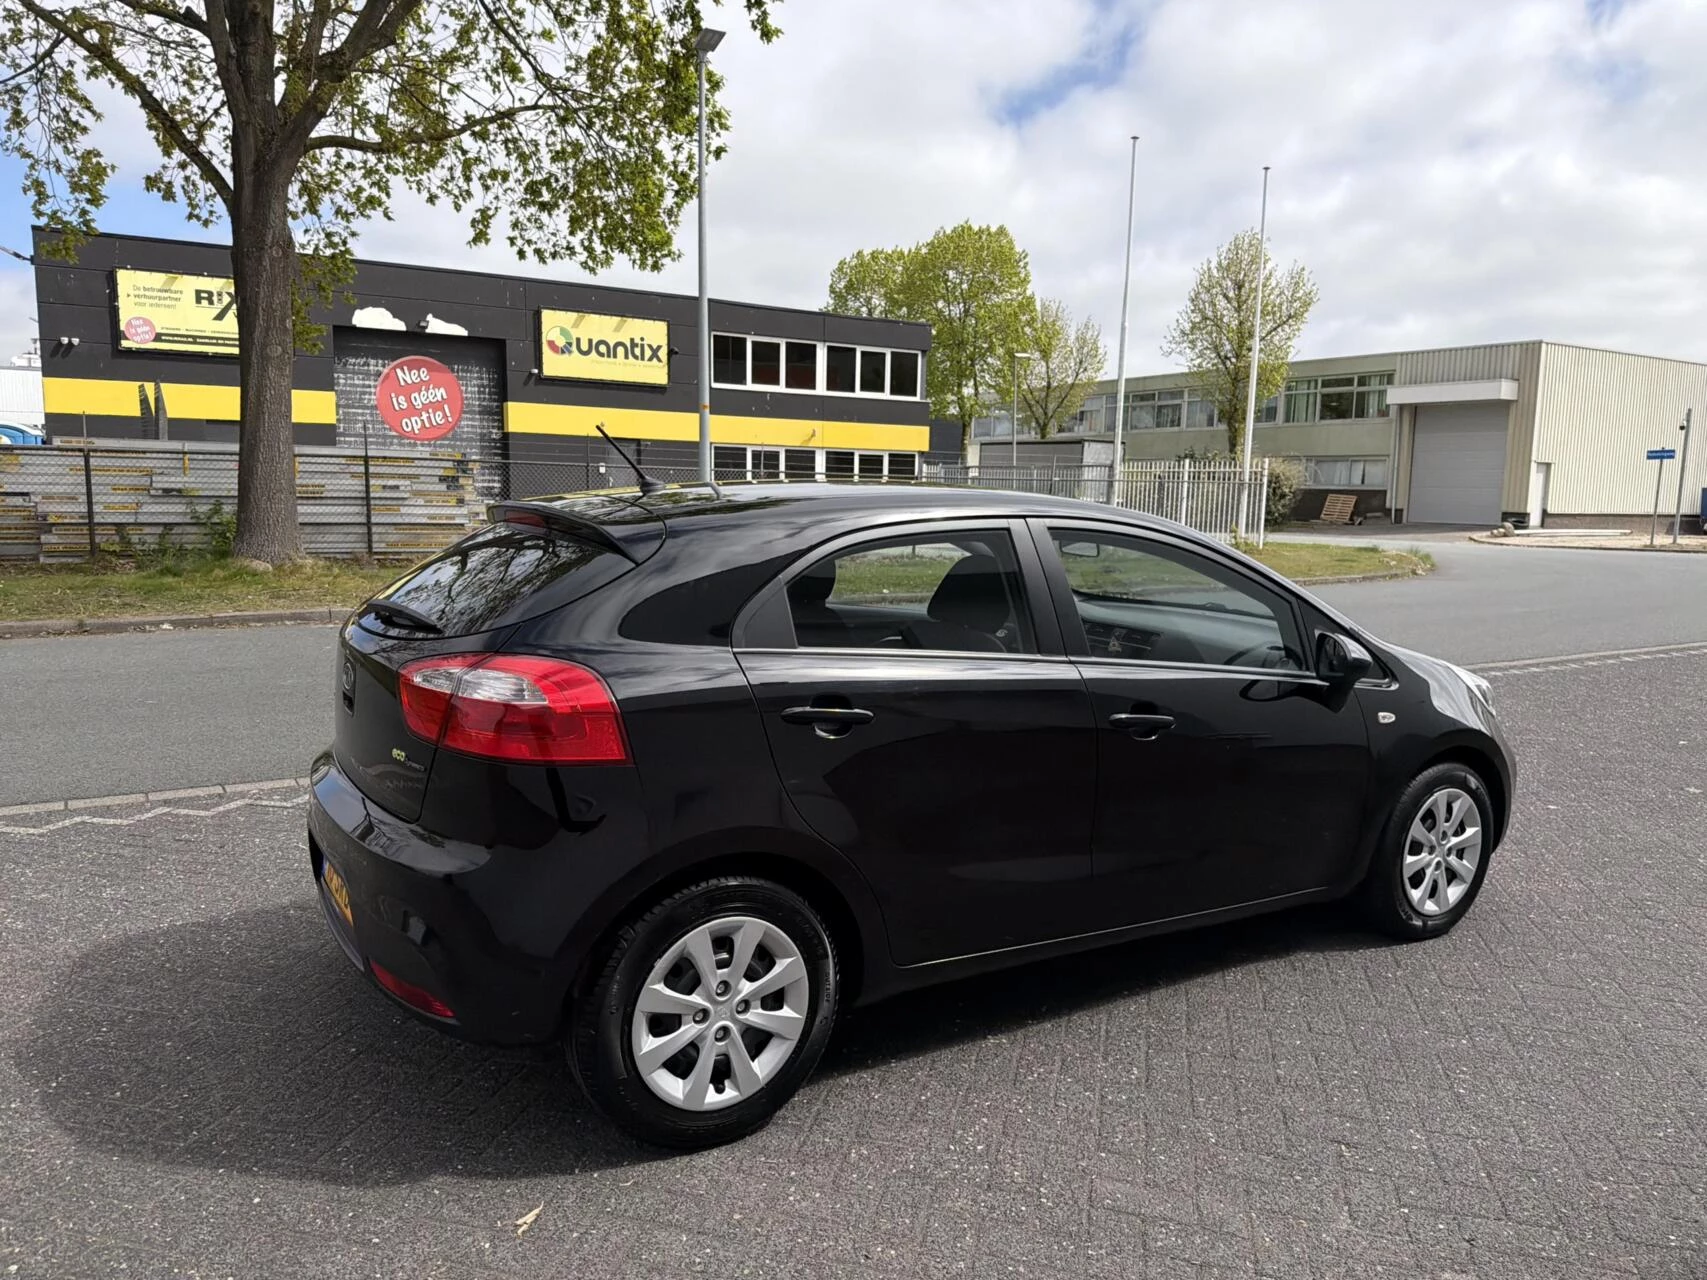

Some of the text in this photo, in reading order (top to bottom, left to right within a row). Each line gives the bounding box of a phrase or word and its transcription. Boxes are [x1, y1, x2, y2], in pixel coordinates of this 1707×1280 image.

[133, 293, 182, 302] verhuurpartner
[395, 365, 430, 386] Nee
[390, 383, 448, 411] is géén
